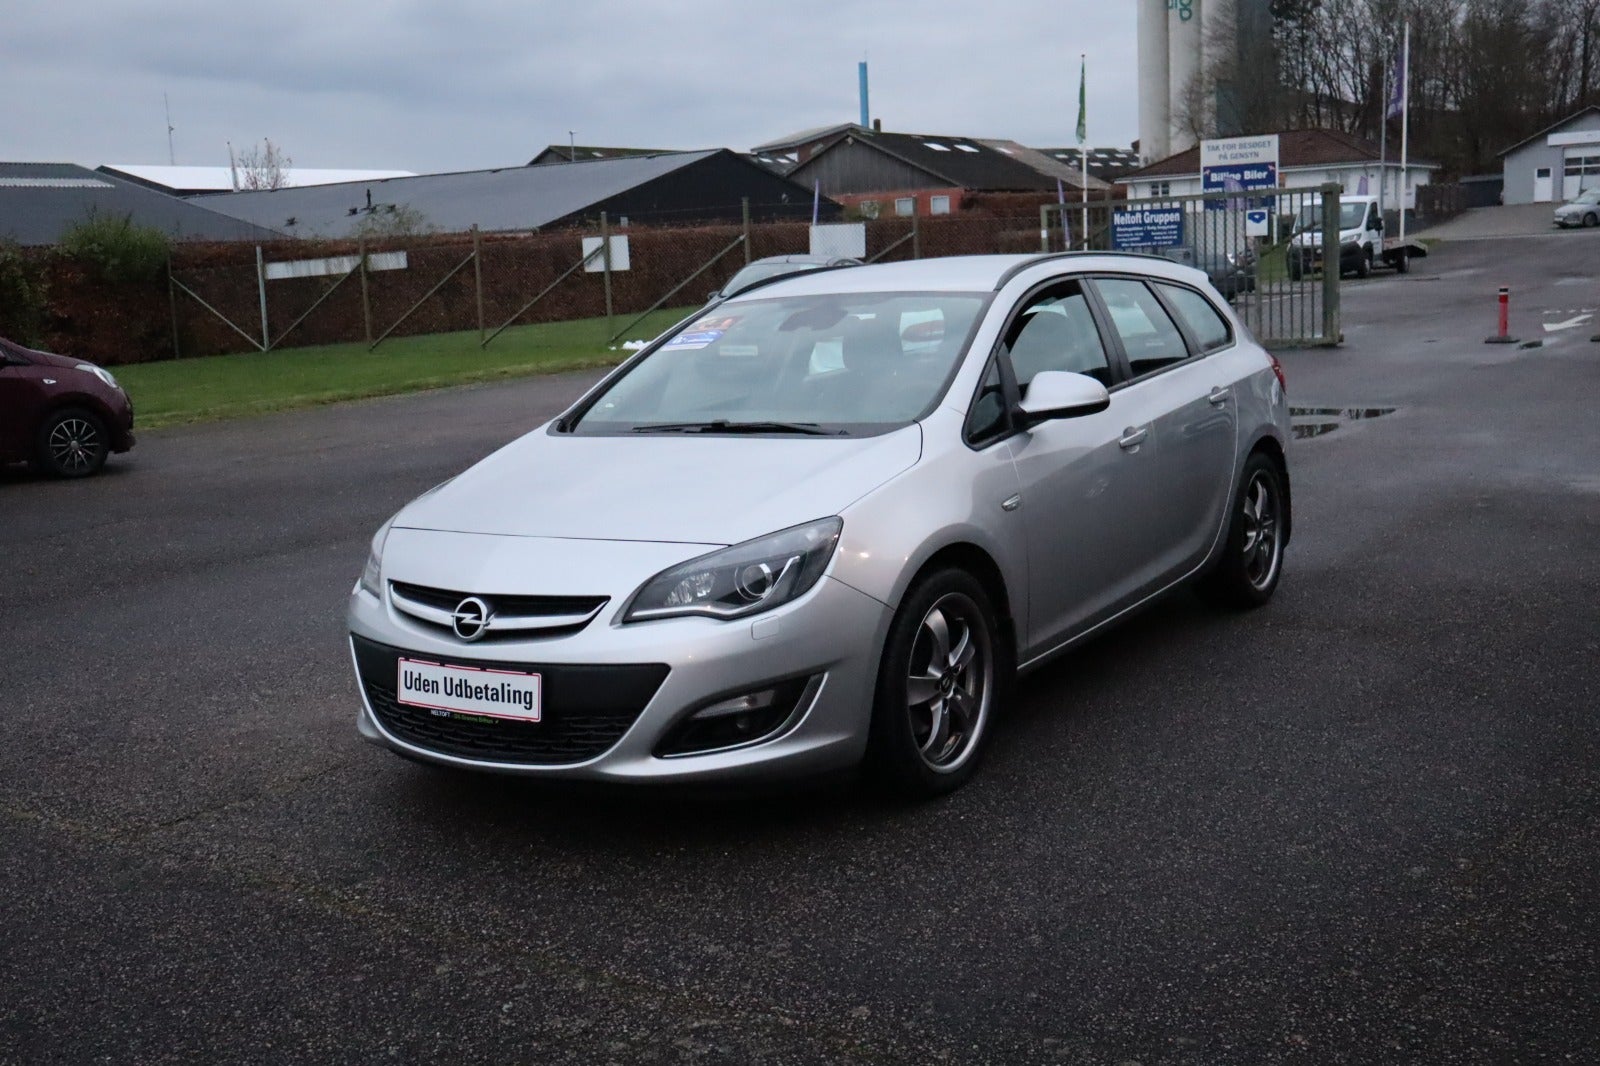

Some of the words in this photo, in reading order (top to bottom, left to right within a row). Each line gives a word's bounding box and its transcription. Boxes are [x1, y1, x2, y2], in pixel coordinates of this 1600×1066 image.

[1207, 144, 1220, 152] TAK
[1222, 143, 1236, 151] FOR
[1238, 141, 1271, 150] BESØGET
[1218, 152, 1229, 160] PÅ
[1230, 151, 1260, 160] GENSYN
[1243, 170, 1268, 180] Biler
[1114, 212, 1142, 225] Neltoft
[1143, 211, 1180, 225] Gruppen
[404, 670, 439, 694] Uden
[443, 676, 533, 710] Udbetaling
